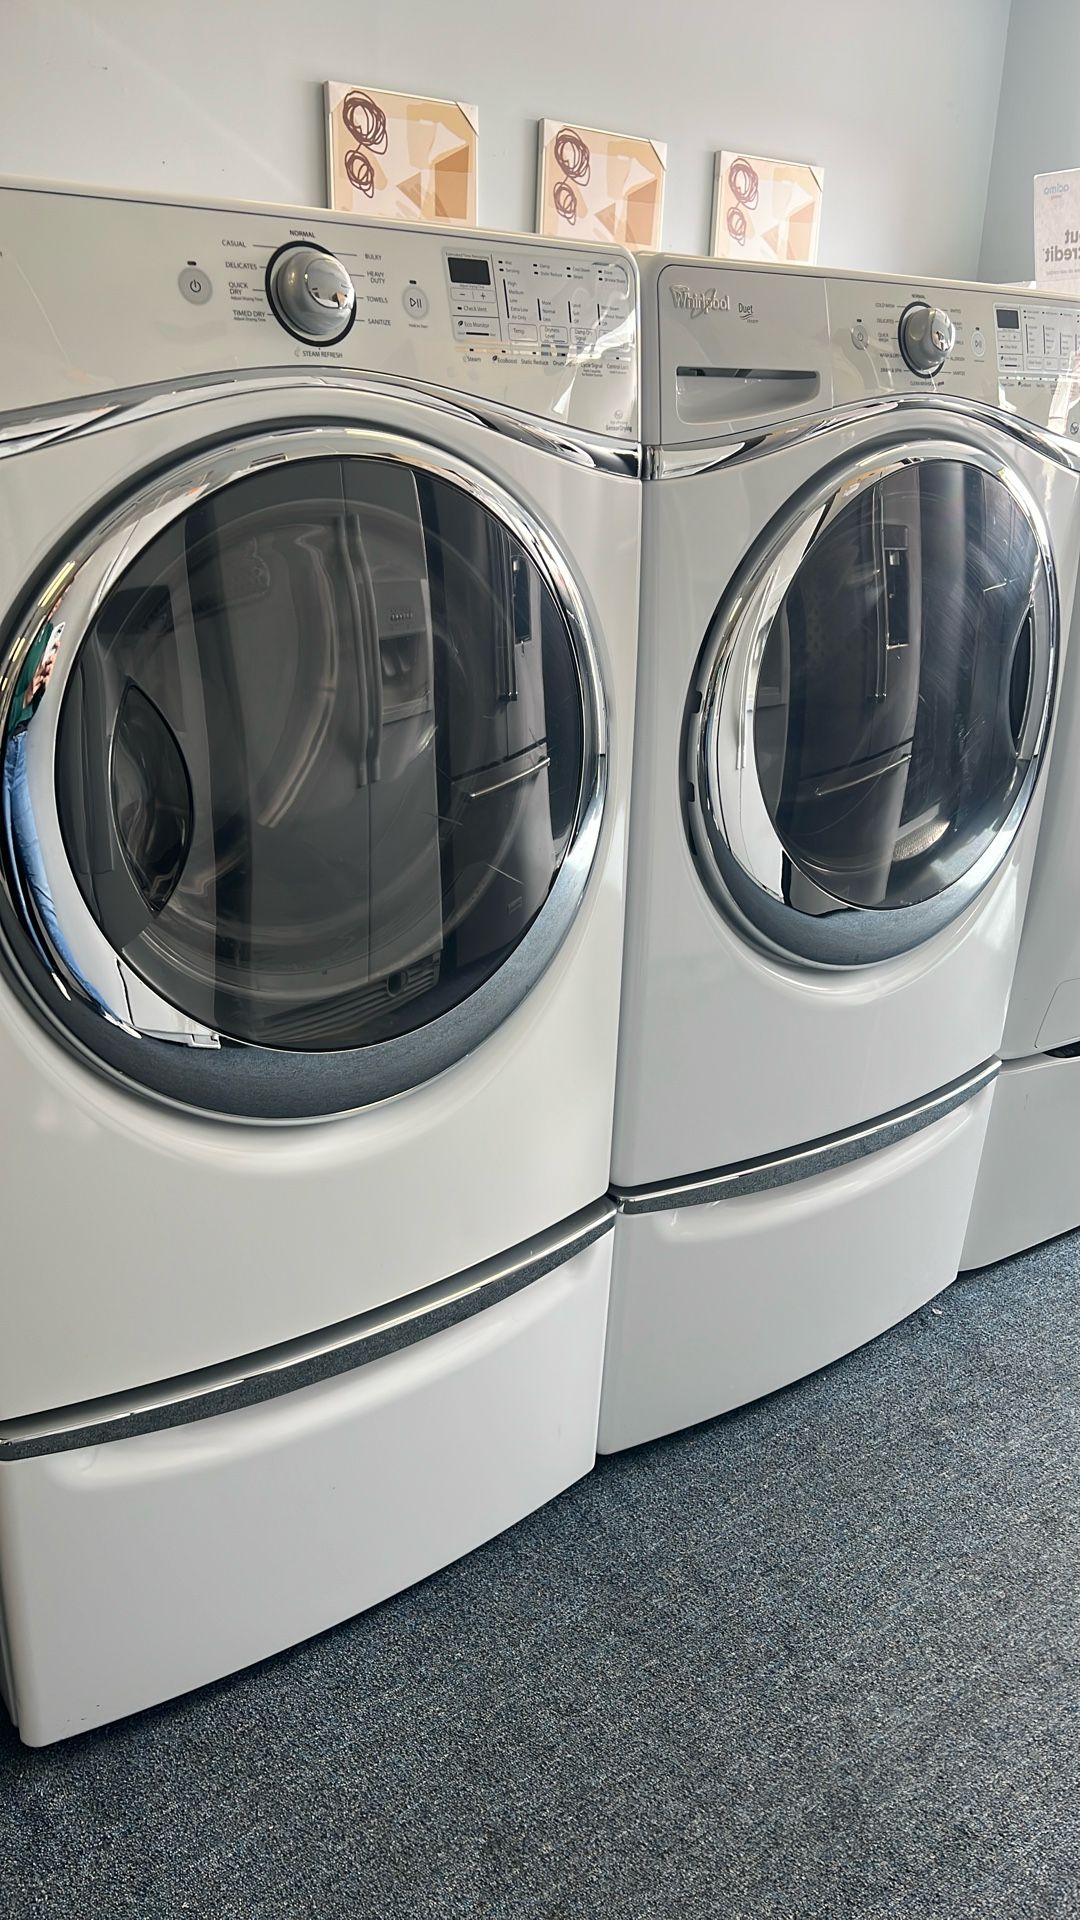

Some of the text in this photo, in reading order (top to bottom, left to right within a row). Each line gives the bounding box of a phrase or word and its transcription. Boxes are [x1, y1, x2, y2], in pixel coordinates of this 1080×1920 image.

[289, 229, 316, 238] NORMAL
[221, 239, 247, 248] CASUAL
[225, 261, 258, 270] DELICATES
[228, 281, 248, 289] QUICK
[670, 284, 730, 318] Whirlpool
[738, 302, 753, 314] Duet
[233, 309, 252, 317] TIMED
[302, 350, 343, 358] STEAM REFRESH
